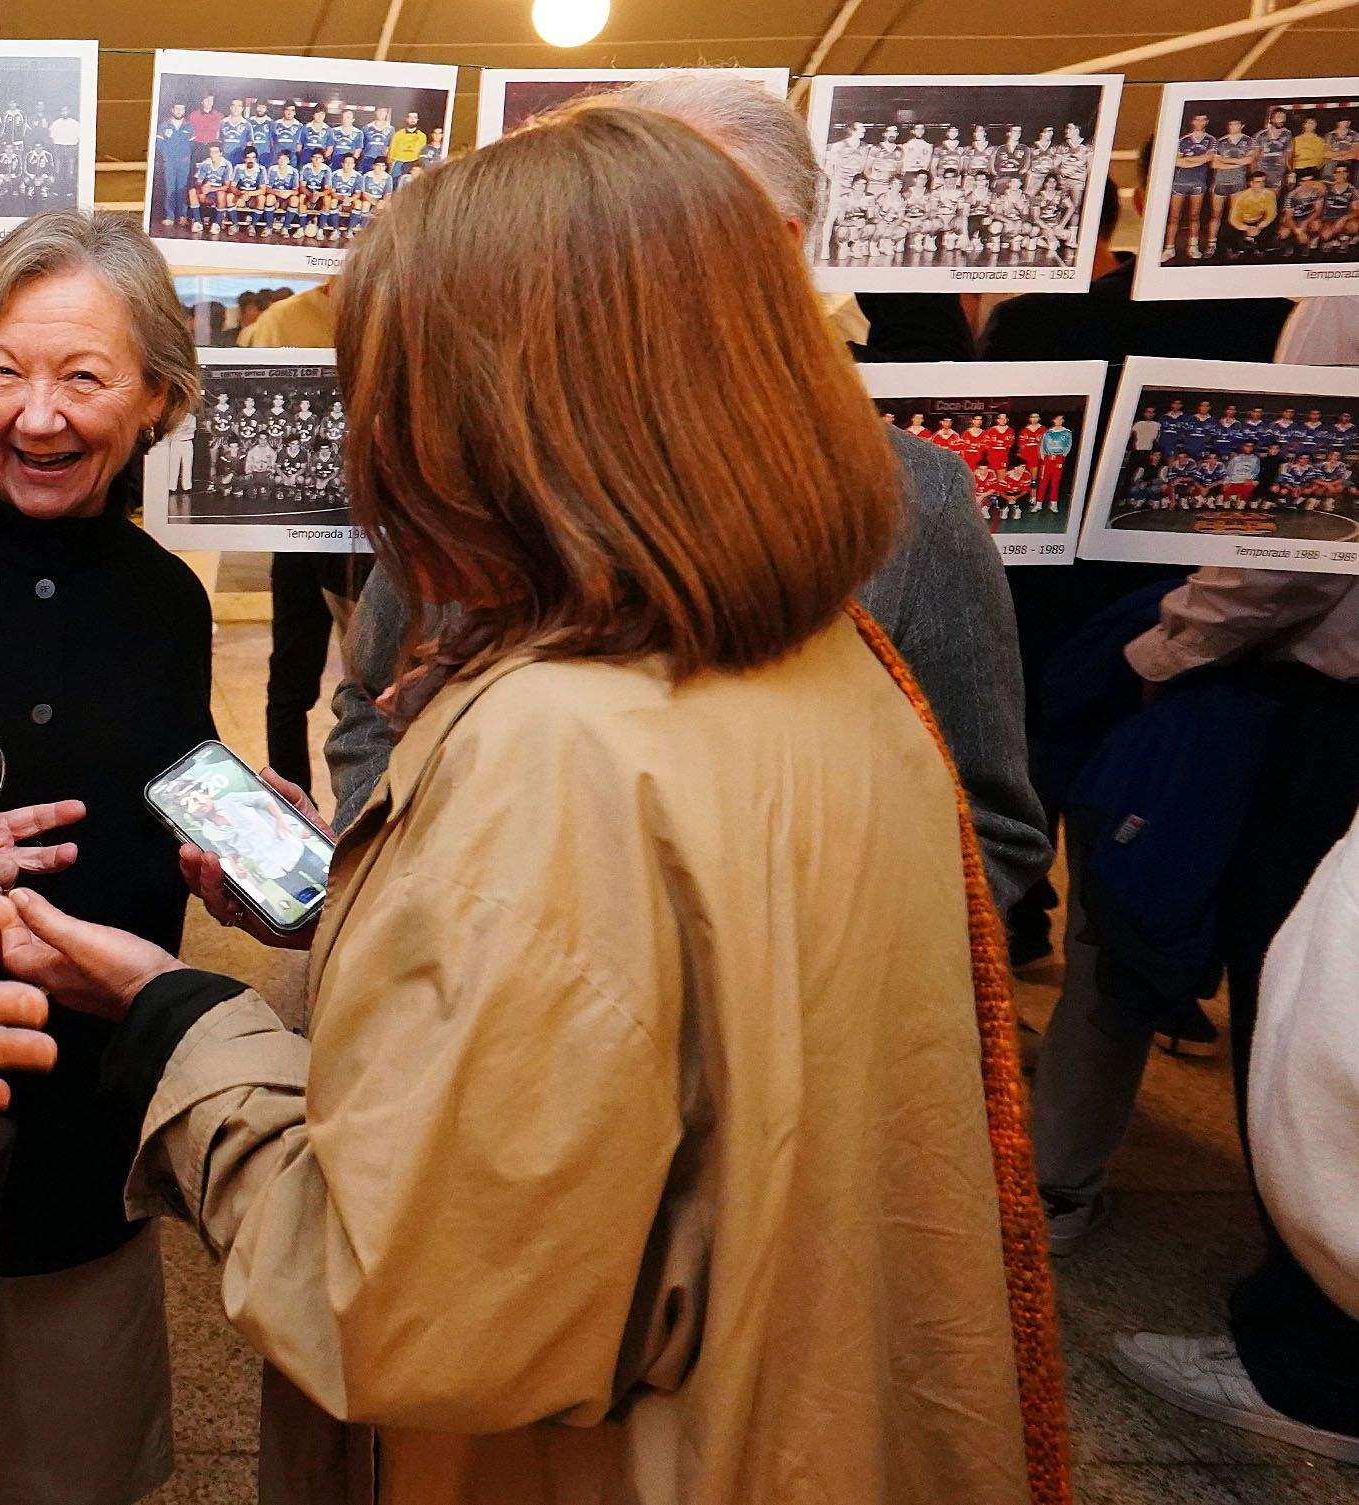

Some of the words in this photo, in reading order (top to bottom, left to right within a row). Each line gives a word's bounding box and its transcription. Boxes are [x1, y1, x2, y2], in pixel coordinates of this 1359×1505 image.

[306, 255, 346, 269] Tempor
[950, 269, 1009, 281] Temporada
[1012, 269, 1037, 280] 1981
[1050, 269, 1076, 280] 1982
[936, 400, 985, 411] Coca-Cola
[287, 528, 344, 540] Temporada
[347, 528, 367, 540] 198
[1002, 545, 1028, 555] 1988
[1039, 544, 1065, 555] 1989
[1234, 545, 1291, 558] Temporada
